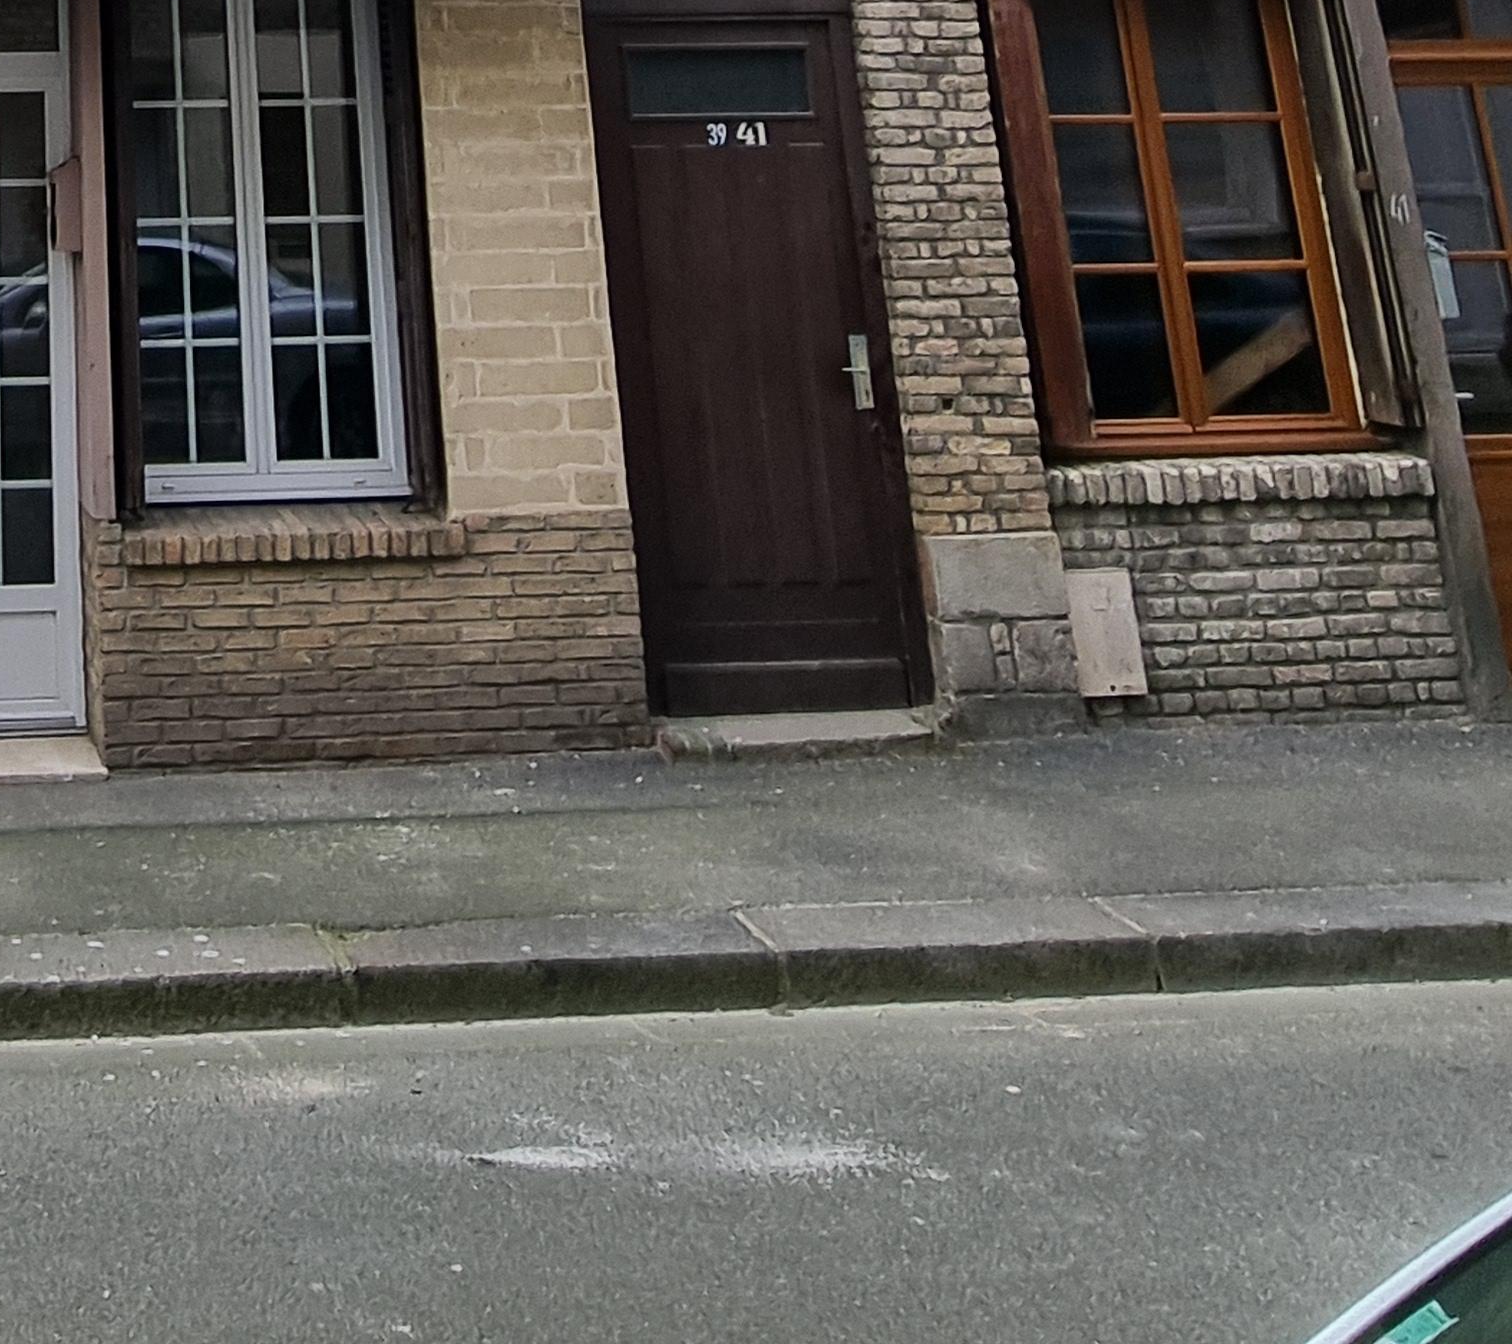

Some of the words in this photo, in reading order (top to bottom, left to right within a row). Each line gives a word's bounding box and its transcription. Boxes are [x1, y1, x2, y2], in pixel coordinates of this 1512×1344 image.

[706, 123, 727, 146] 39
[735, 121, 768, 146] 41
[1390, 193, 1410, 226] 41
